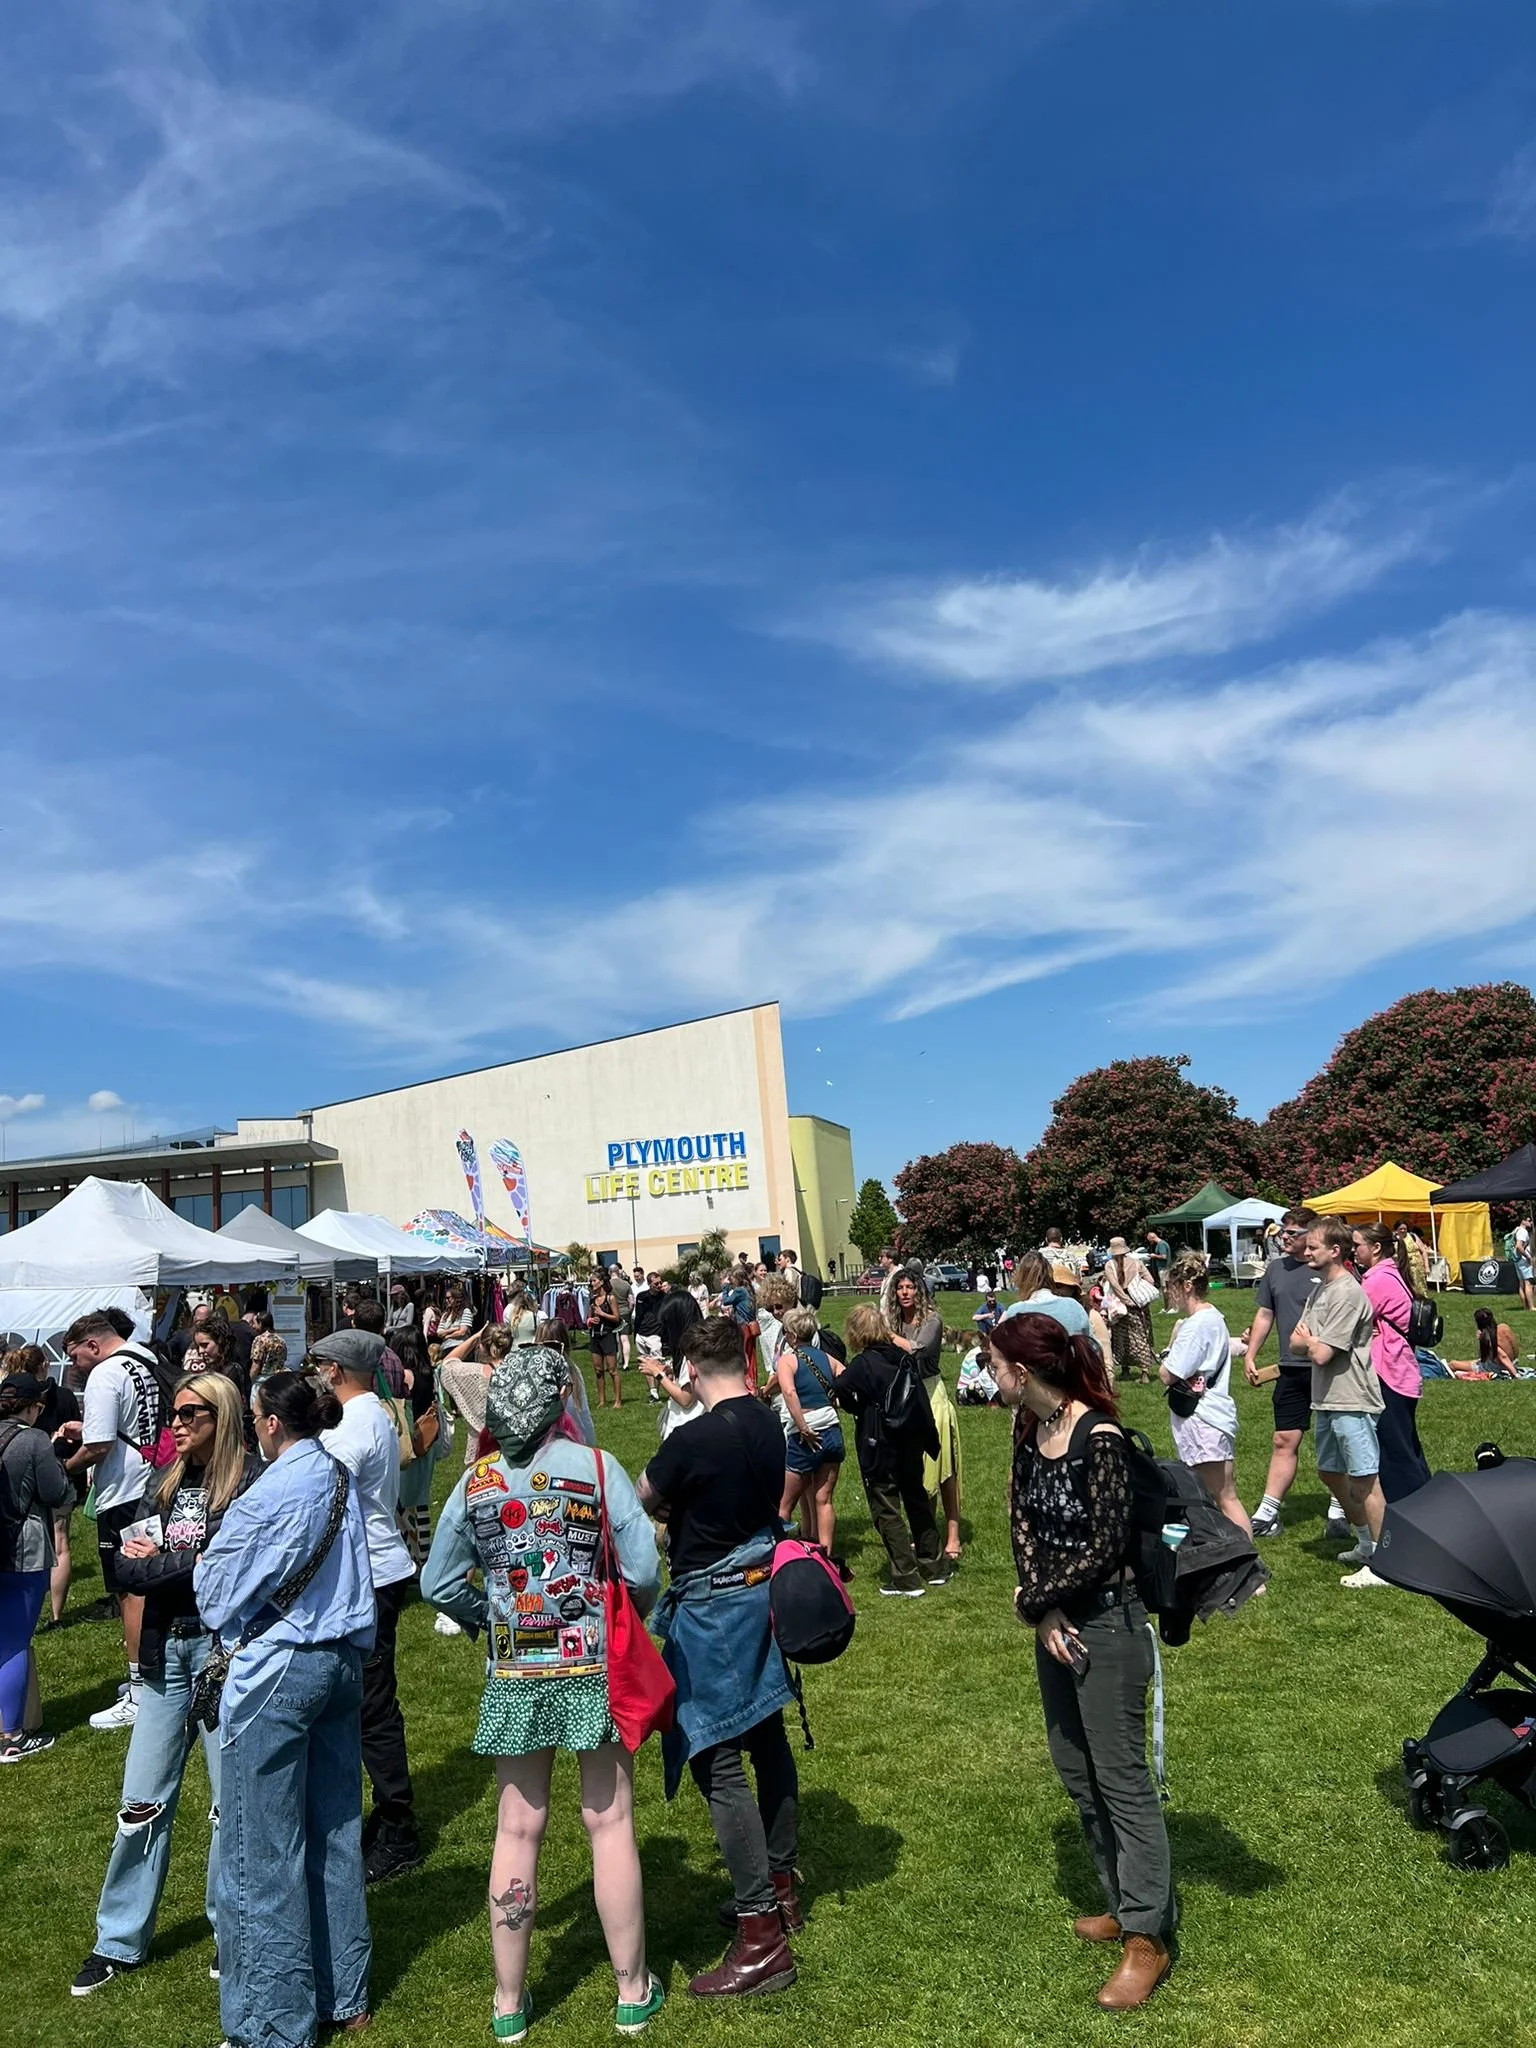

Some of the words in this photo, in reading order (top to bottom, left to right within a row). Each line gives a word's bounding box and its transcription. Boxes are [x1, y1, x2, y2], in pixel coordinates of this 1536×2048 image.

[607, 1131, 746, 1167] PLYMOUTH
[585, 1172, 640, 1203] LIFE
[648, 1162, 749, 1198] CENTRE
[121, 1361, 151, 1446] EVERYWHE
[567, 1530, 598, 1542] MUSE
